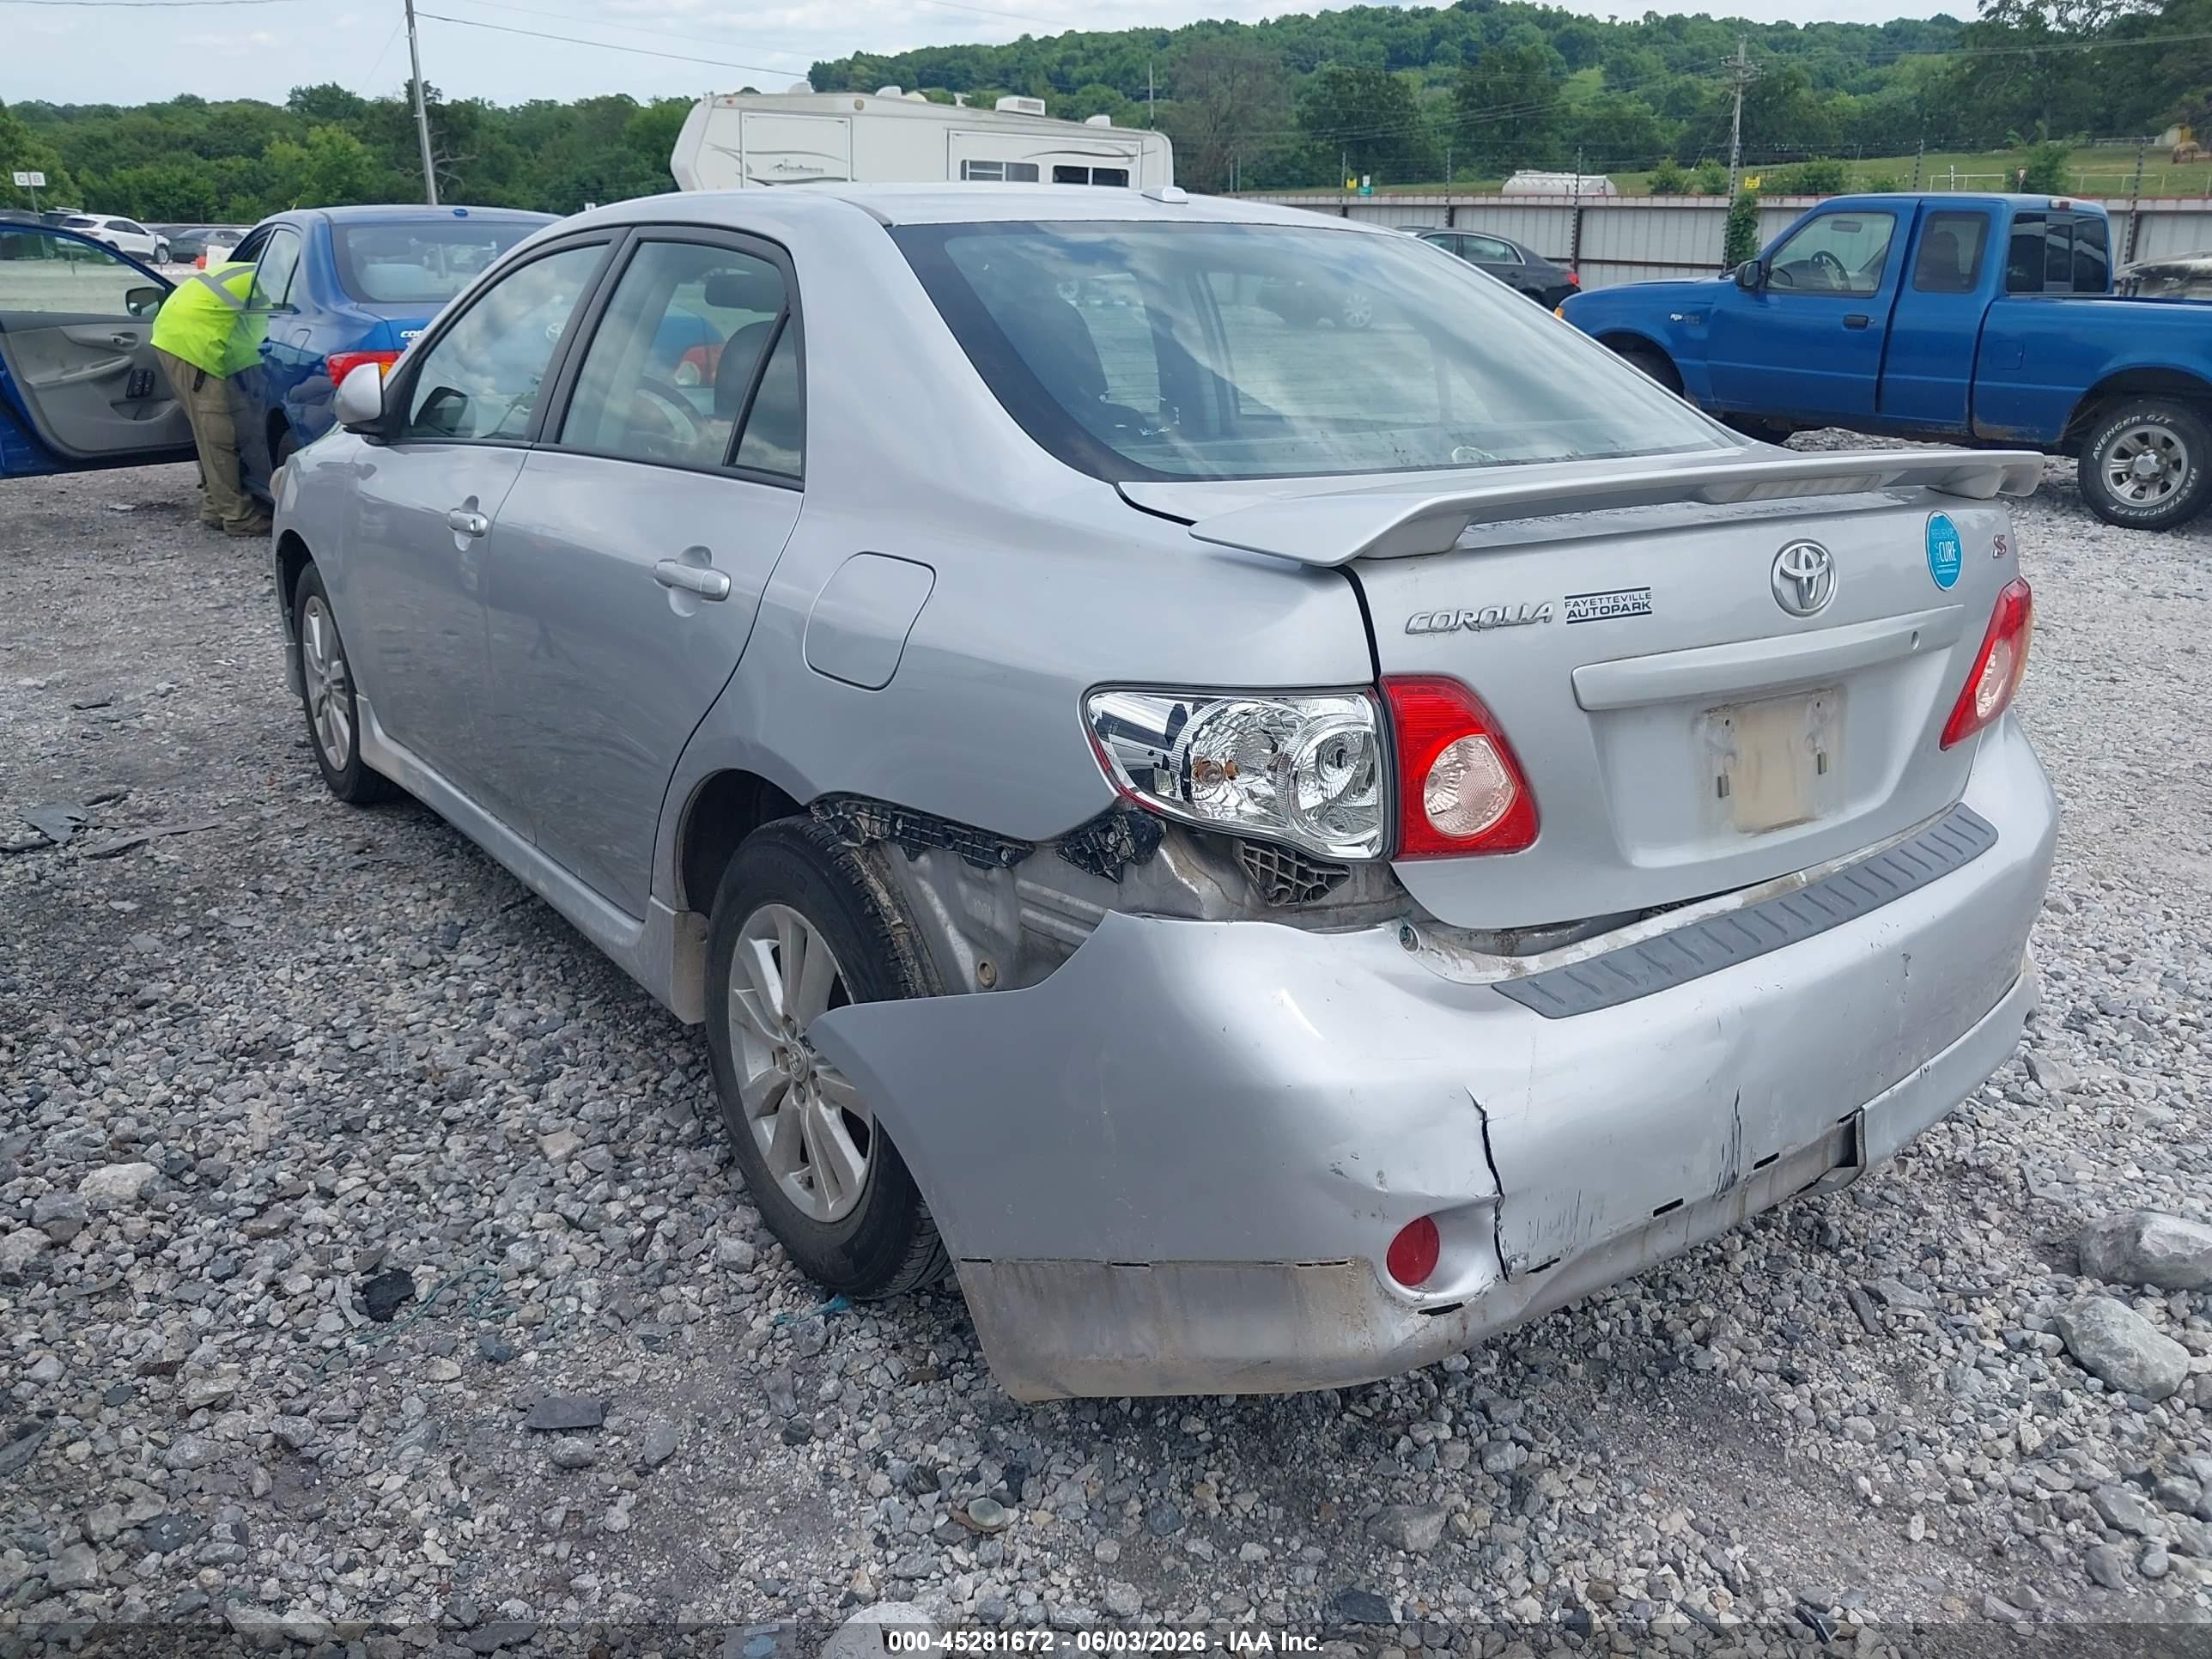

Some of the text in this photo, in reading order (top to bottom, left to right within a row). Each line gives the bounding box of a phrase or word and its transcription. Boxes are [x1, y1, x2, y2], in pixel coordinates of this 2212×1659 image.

[2093, 415, 2141, 460] AVENGER
[2108, 468, 2197, 517] MASTERCRAFT
[1938, 540, 1957, 562] CURE
[1992, 534, 2007, 559] S
[1564, 592, 1652, 610] FAYETTEVILLE
[1566, 601, 1651, 619] AUTOPARK
[1405, 601, 1553, 635] COROLLA
